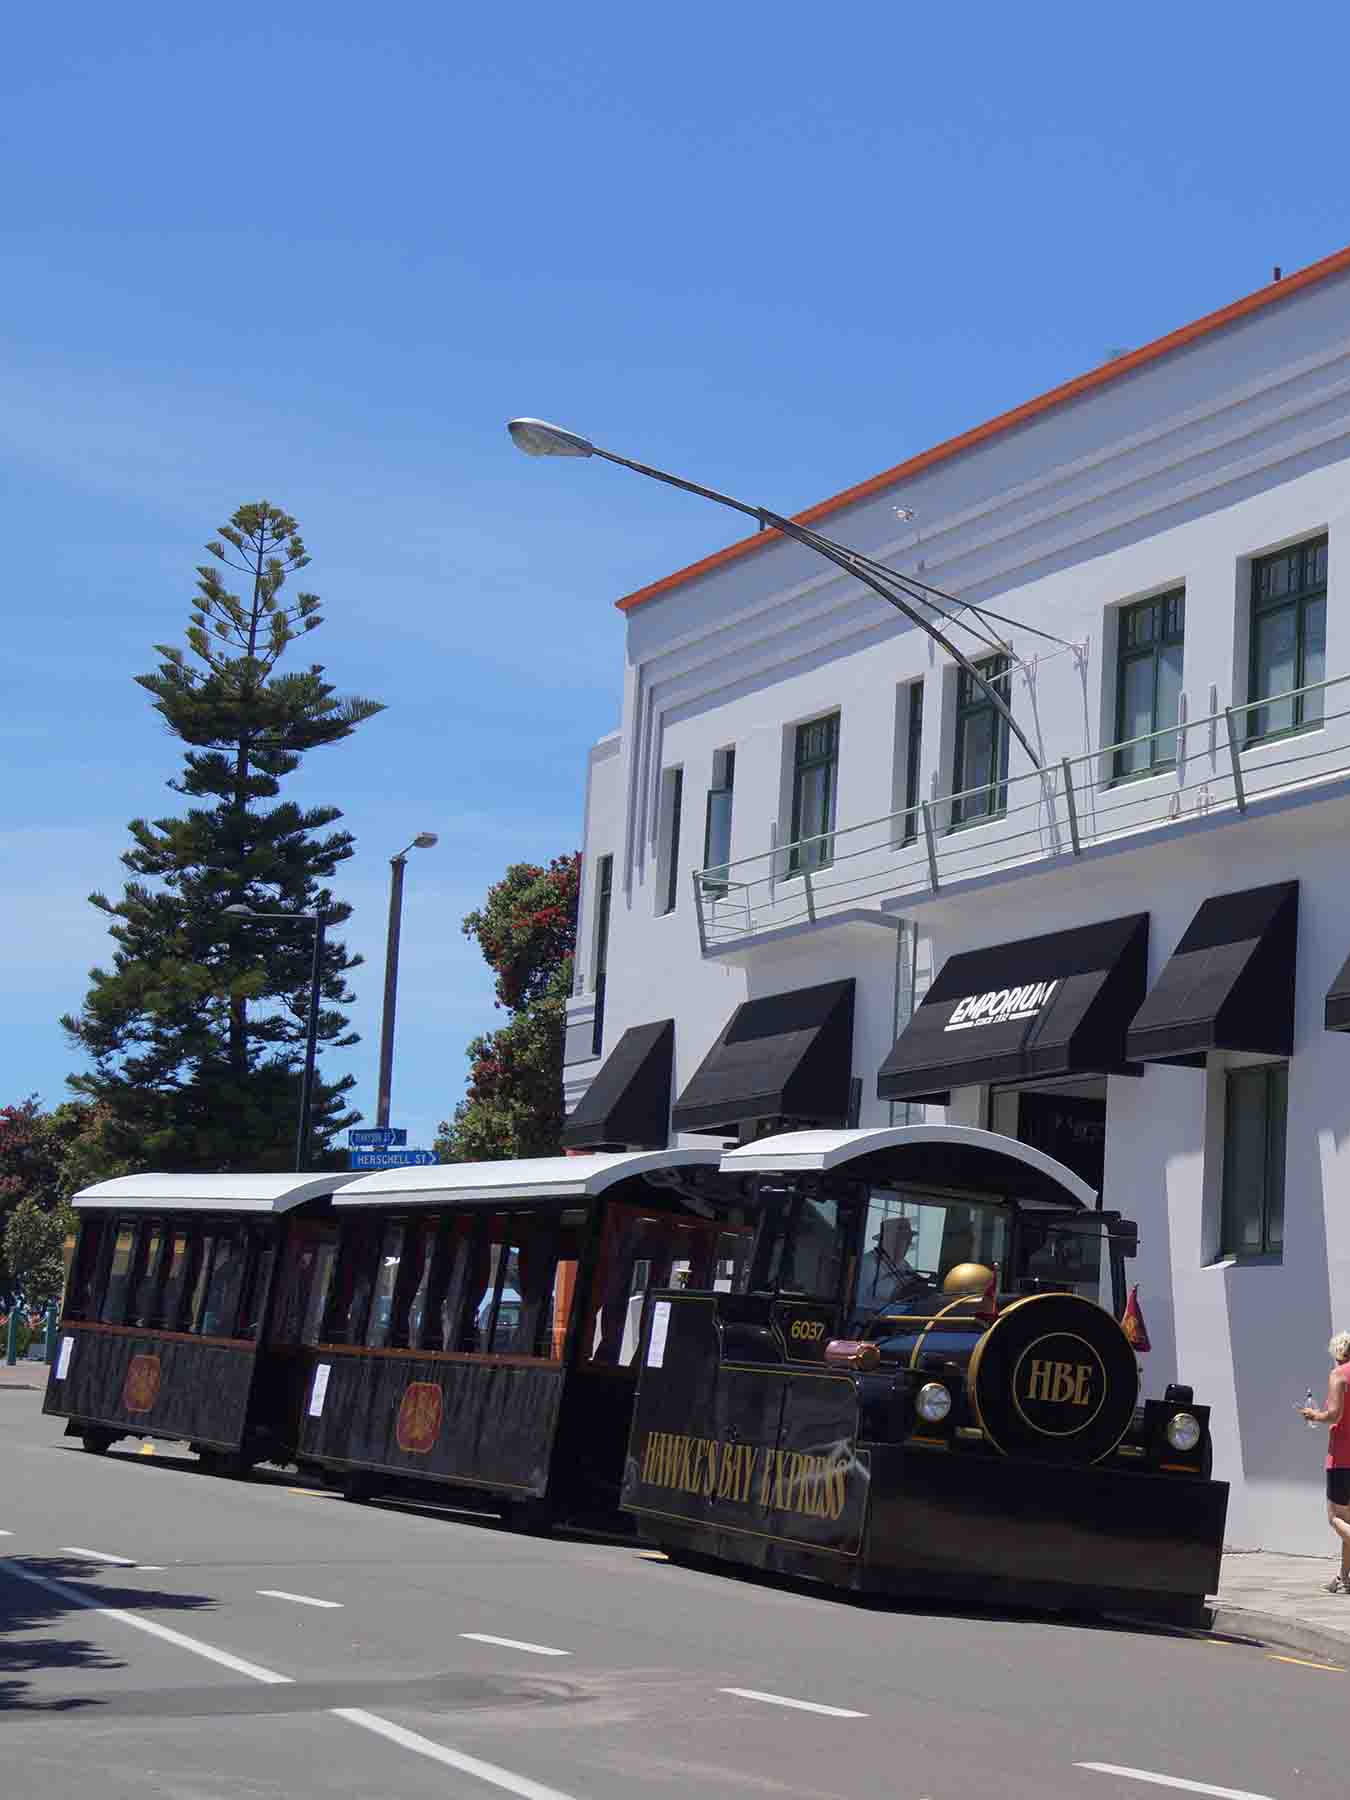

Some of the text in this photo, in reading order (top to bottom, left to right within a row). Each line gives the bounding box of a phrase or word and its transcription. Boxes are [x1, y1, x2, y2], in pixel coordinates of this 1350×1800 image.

[949, 980, 1058, 1024] EMPORIUM
[358, 1154, 426, 1165] HERSCHELL ST
[791, 1319, 825, 1344] 6037
[1024, 1359, 1093, 1405] HBE
[642, 1431, 848, 1521] HAWKE'S BAY EXPRESS
